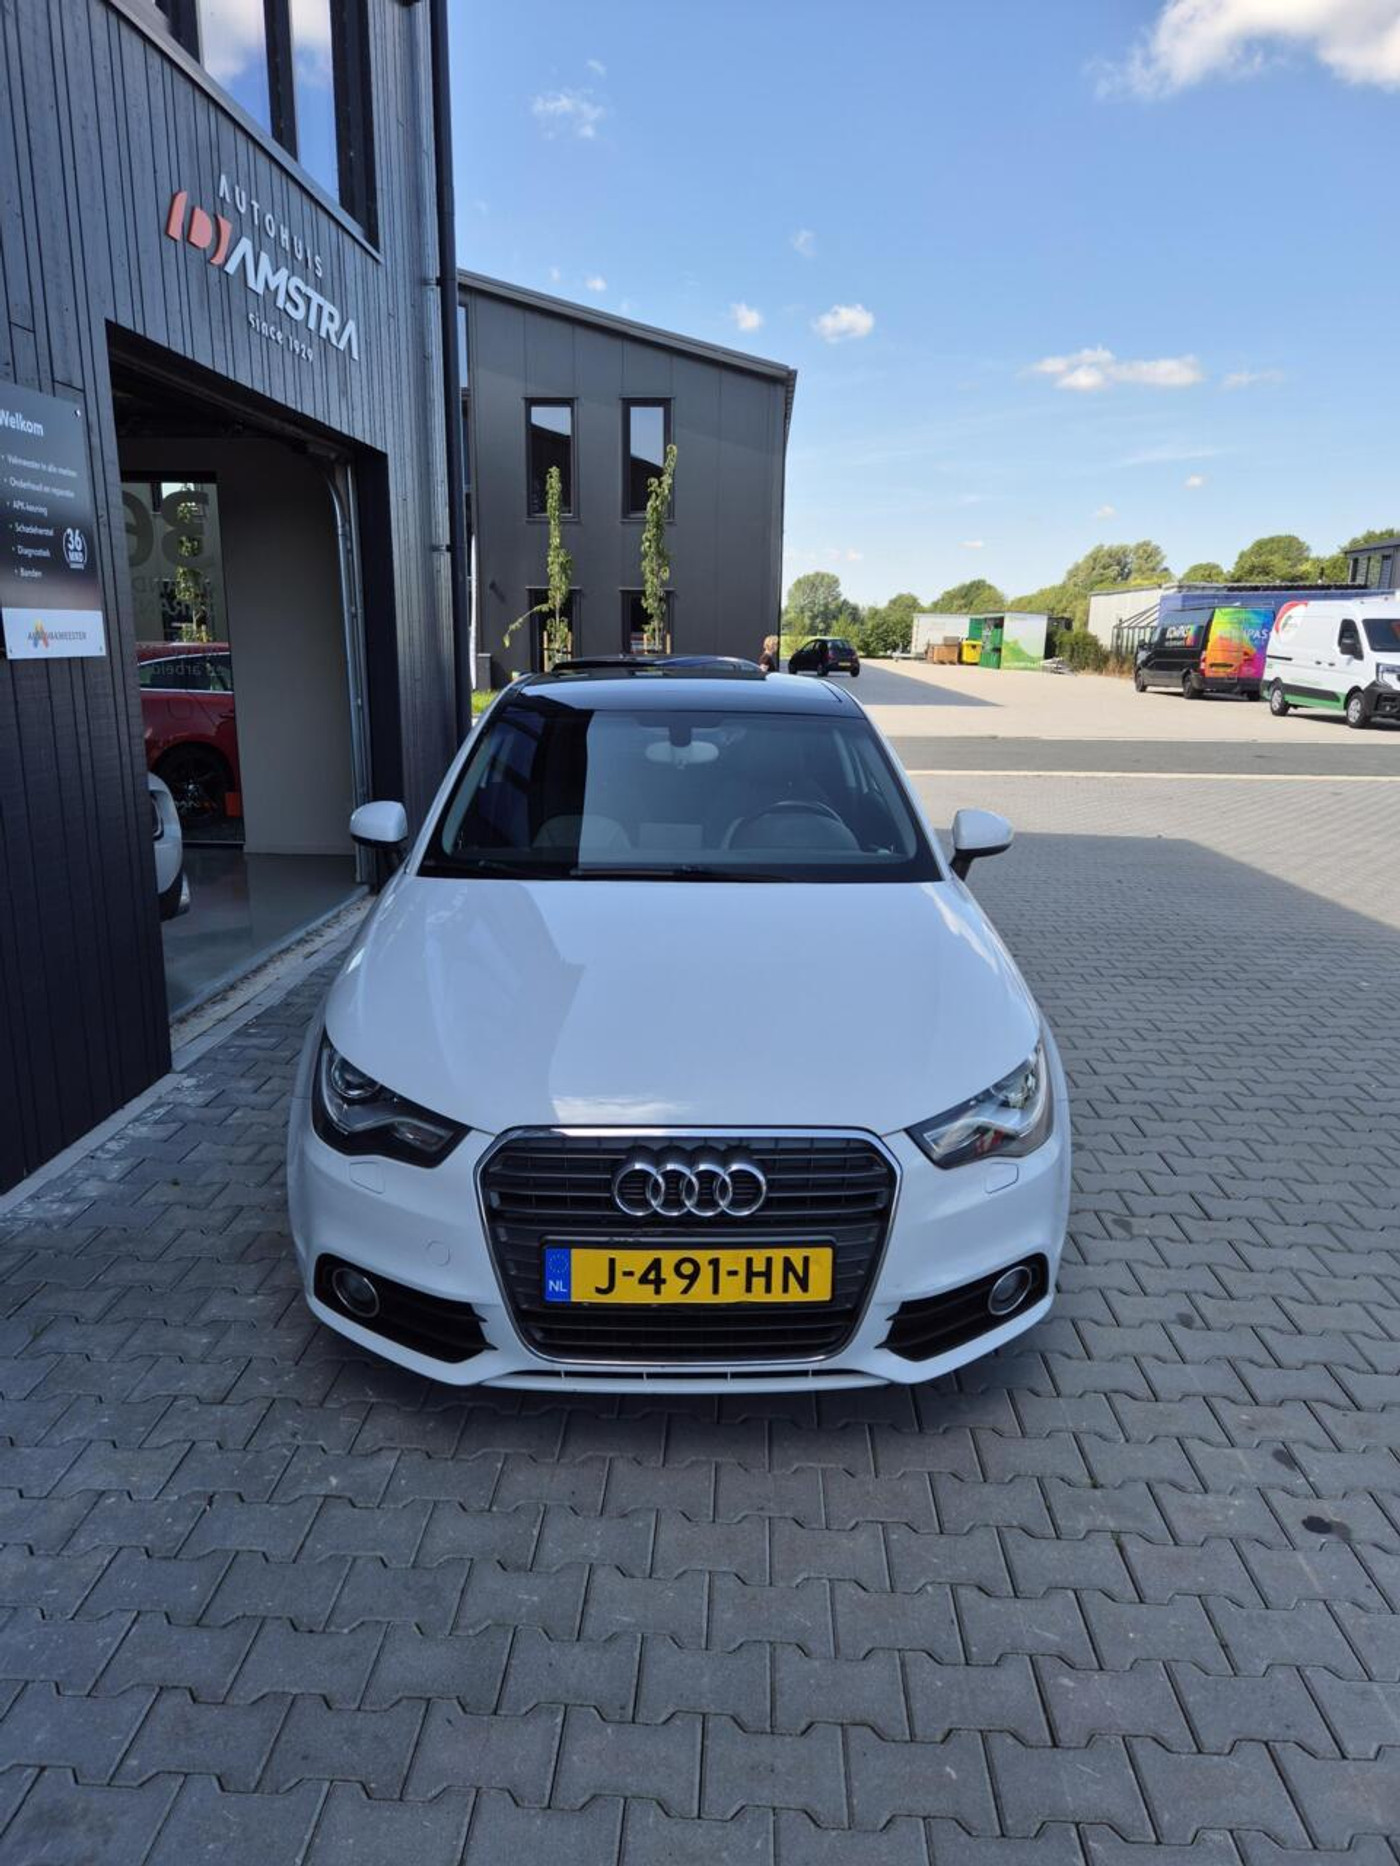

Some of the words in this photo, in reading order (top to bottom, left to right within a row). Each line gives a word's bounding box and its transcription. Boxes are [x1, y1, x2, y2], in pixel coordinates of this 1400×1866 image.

[219, 174, 323, 278] AUTOHUIS
[249, 313, 283, 346] since
[288, 335, 314, 362] 1929
[0, 408, 44, 436] Welkom
[66, 527, 83, 551] 36
[549, 1280, 568, 1292] NL
[594, 1256, 810, 1295] J-491-HN
